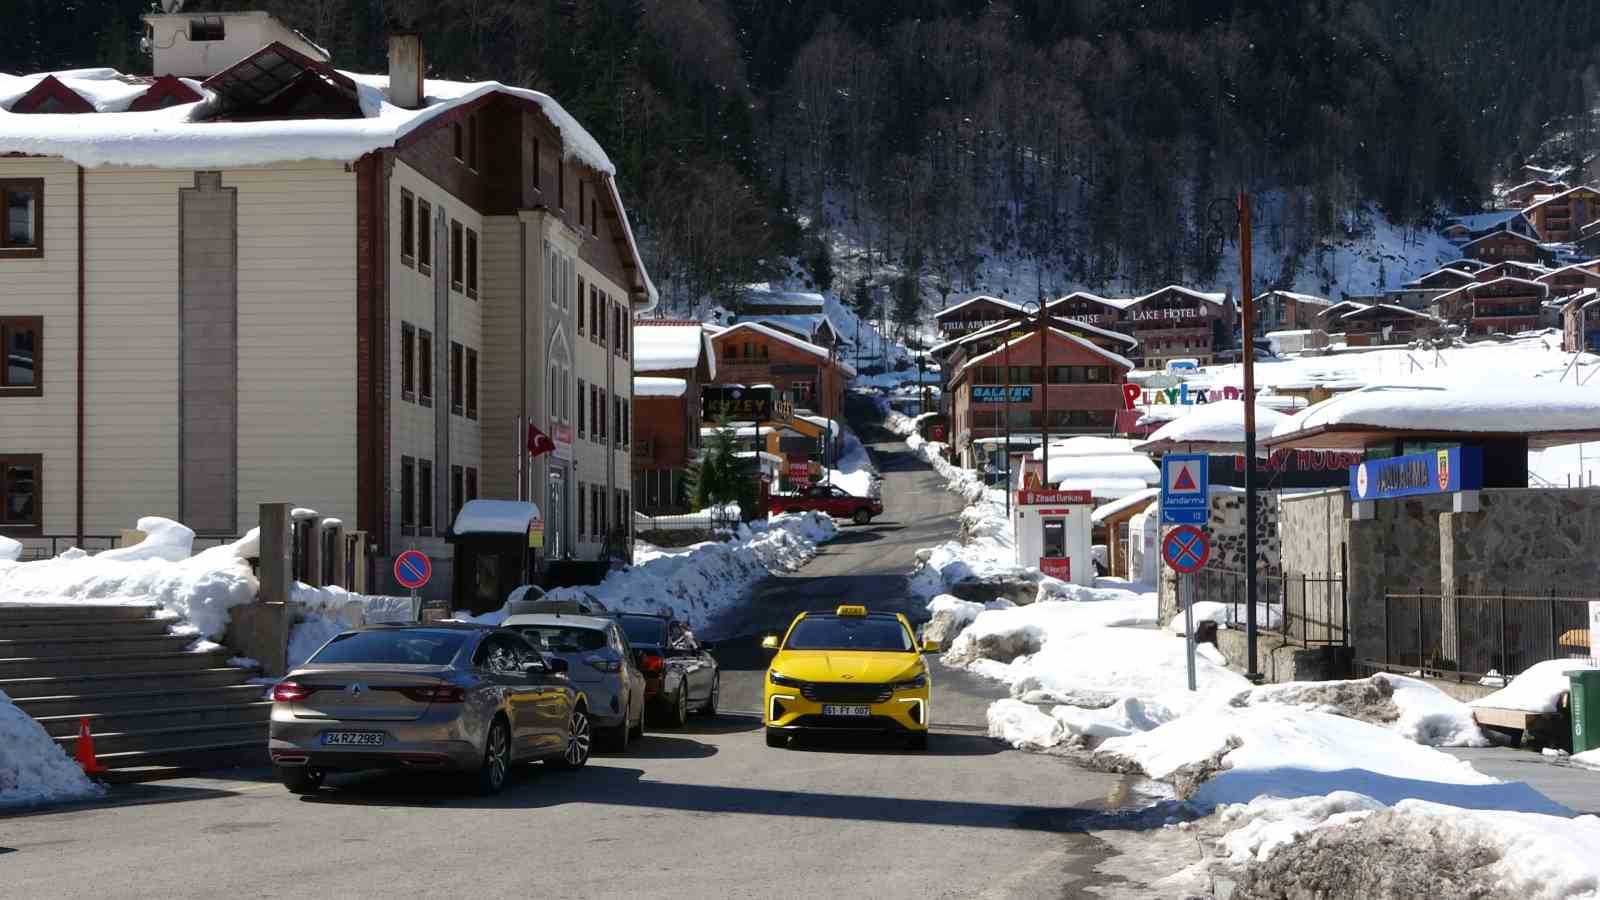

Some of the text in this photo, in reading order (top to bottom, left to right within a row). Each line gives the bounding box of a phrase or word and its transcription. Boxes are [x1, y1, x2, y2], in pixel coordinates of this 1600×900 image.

[1132, 307, 1197, 321] LAKE HOTEL
[1165, 495, 1206, 505] Jandarma
